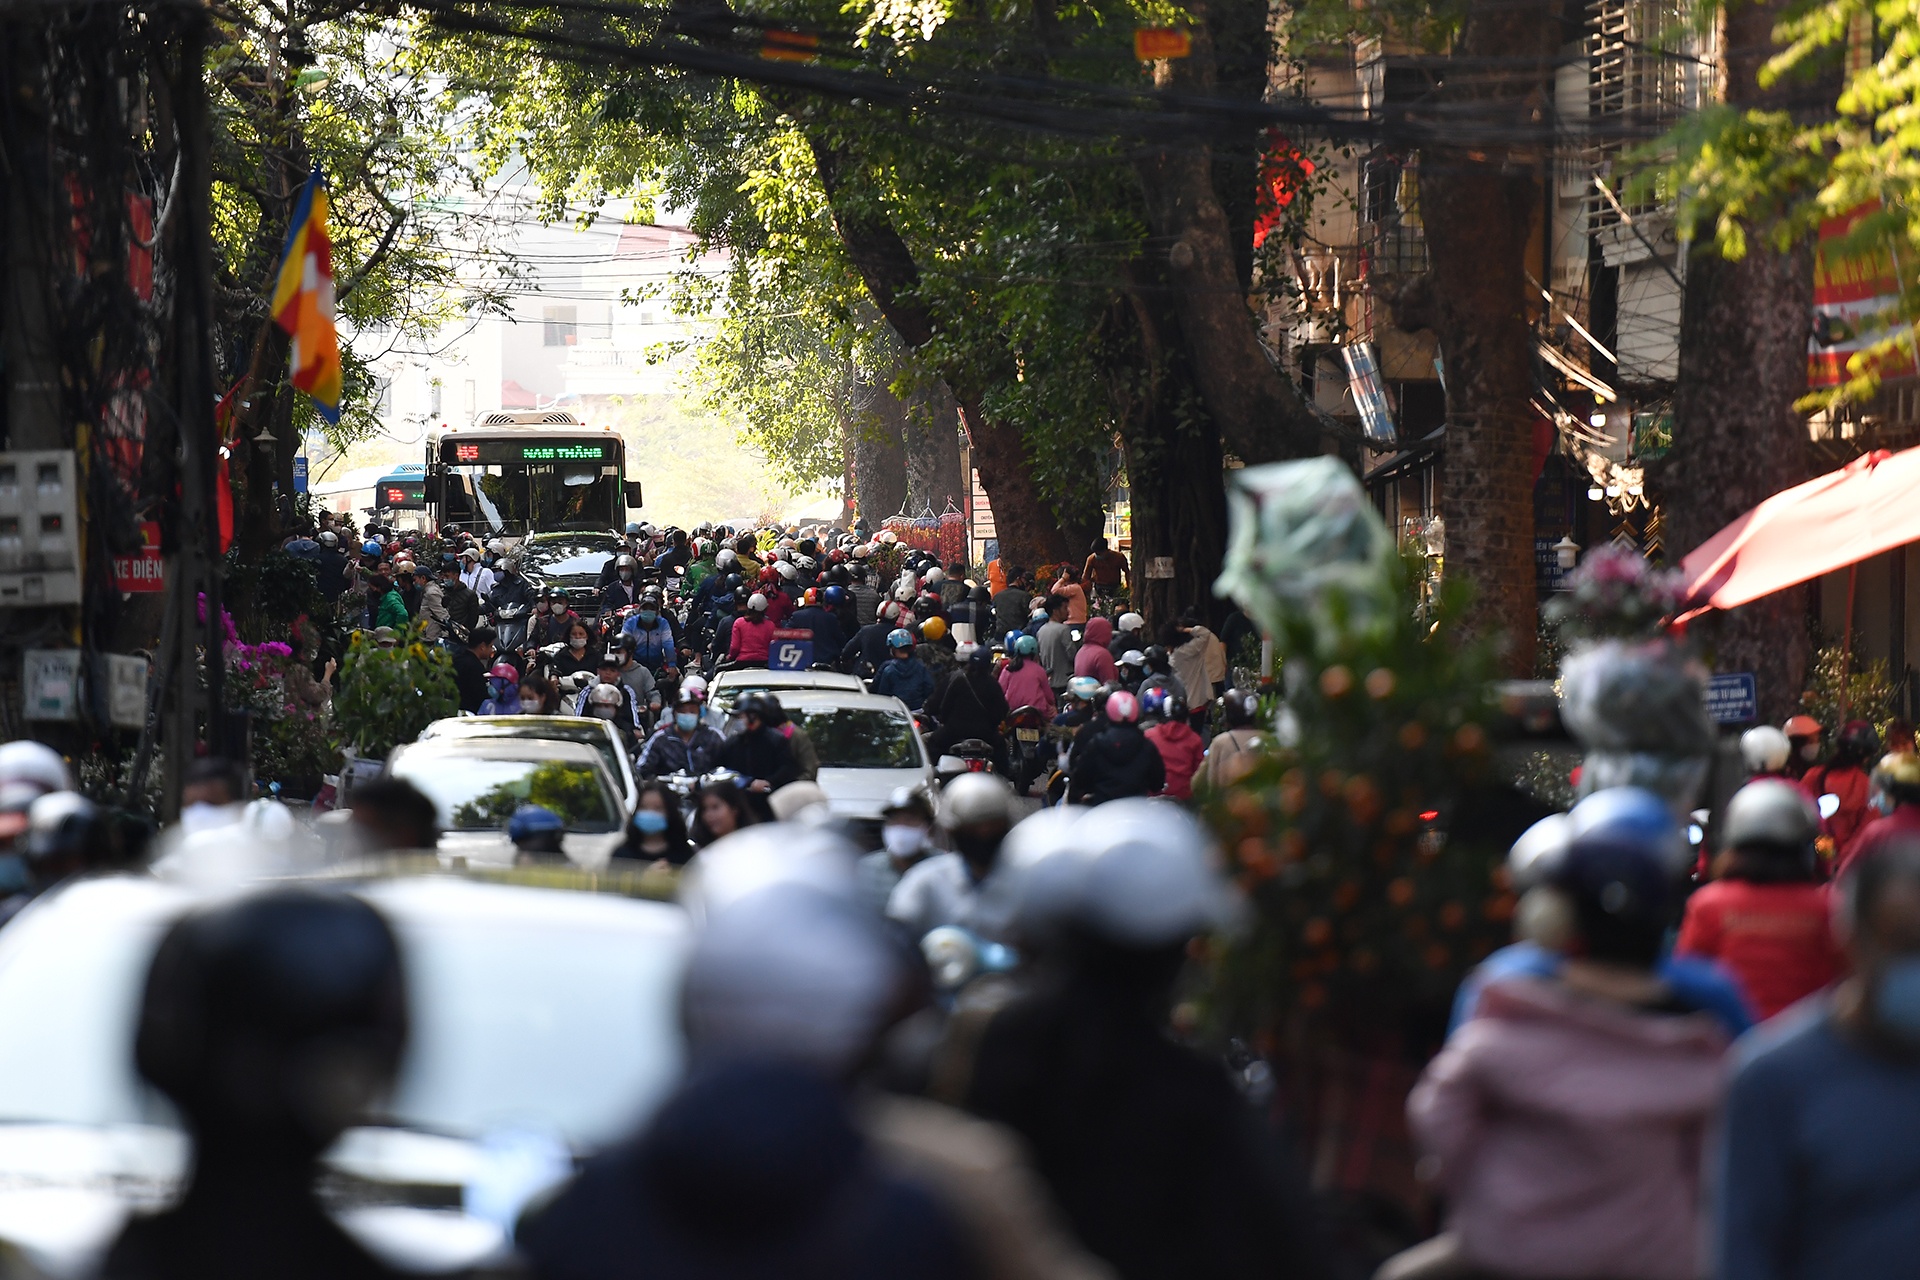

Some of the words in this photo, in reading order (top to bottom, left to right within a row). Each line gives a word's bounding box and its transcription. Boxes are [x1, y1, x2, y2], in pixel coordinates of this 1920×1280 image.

[523, 448, 554, 459] NAM
[113, 559, 129, 579] XE
[779, 643, 803, 668] G7
